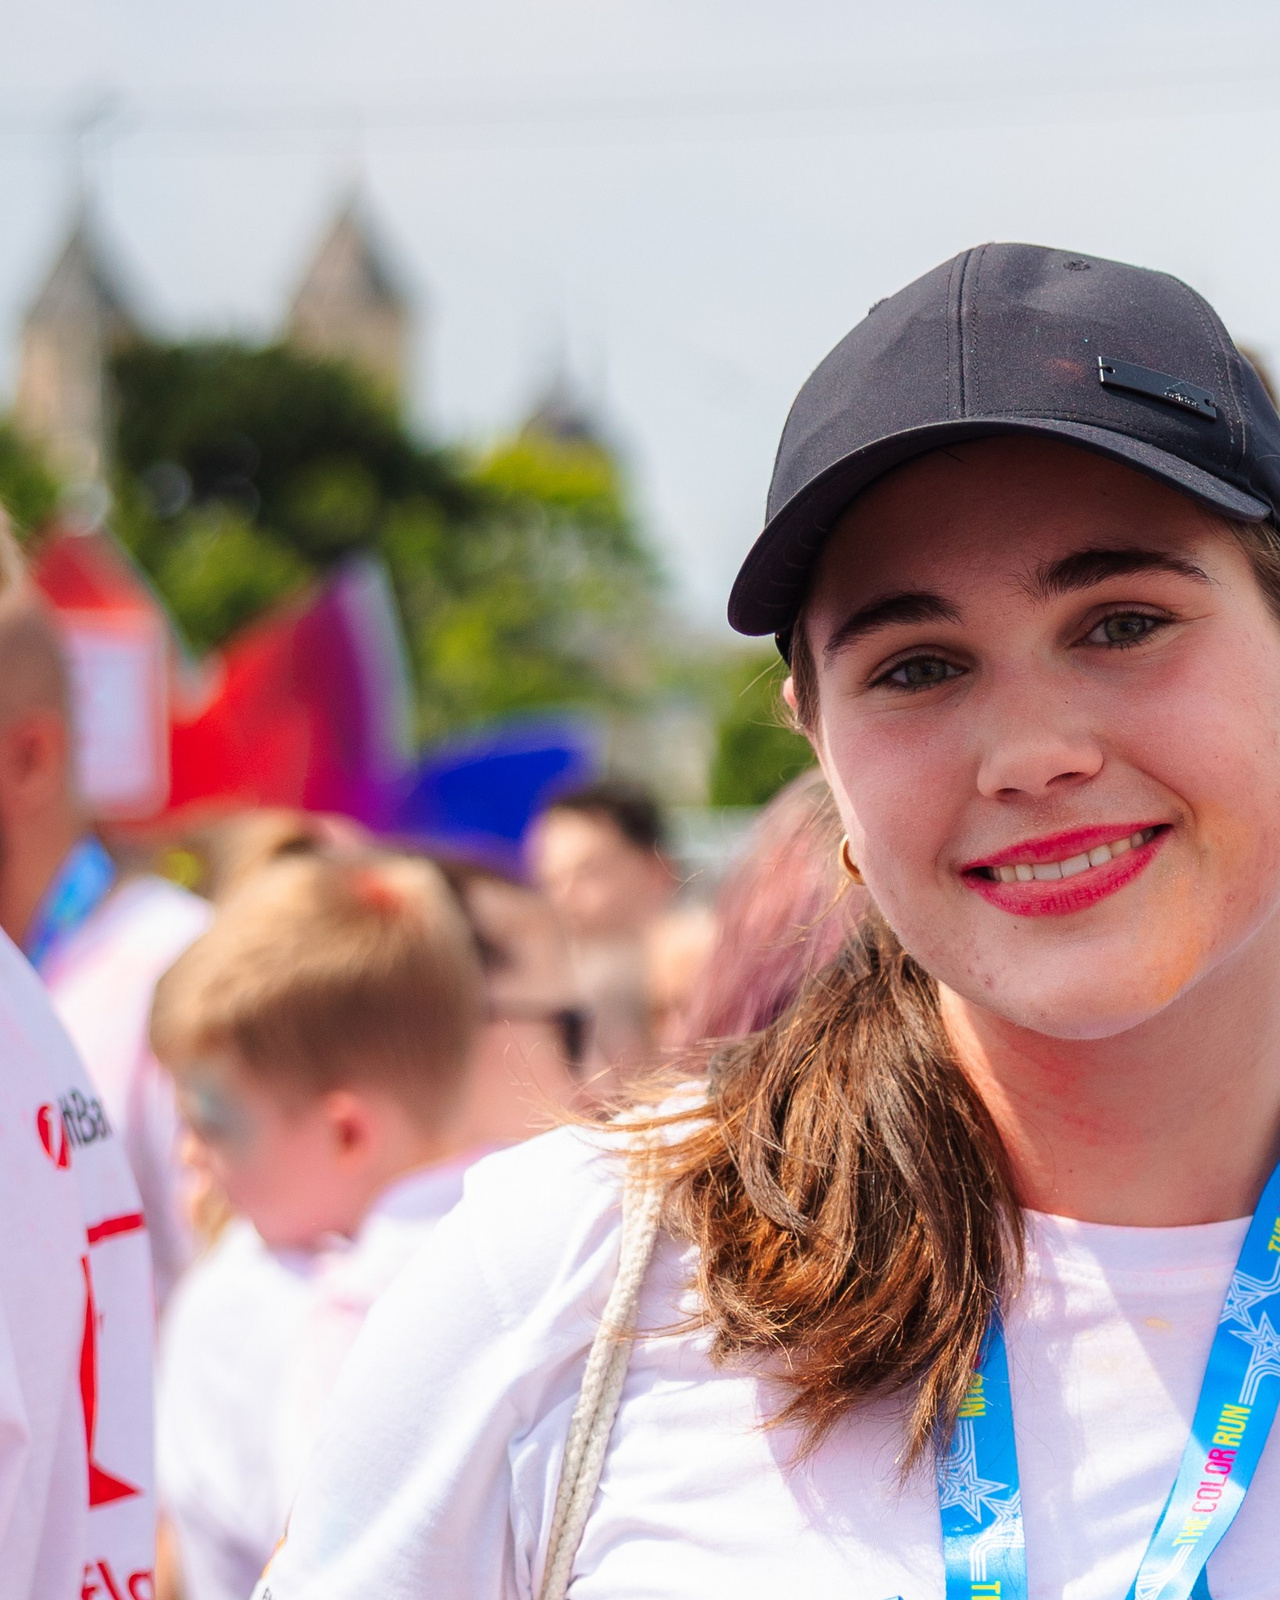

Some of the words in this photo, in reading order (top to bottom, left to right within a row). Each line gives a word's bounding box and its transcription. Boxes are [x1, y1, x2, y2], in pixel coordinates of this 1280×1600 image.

[1213, 1403, 1252, 1447] RUN
[1192, 1448, 1238, 1513] COLOR
[1172, 1516, 1213, 1547] THE
